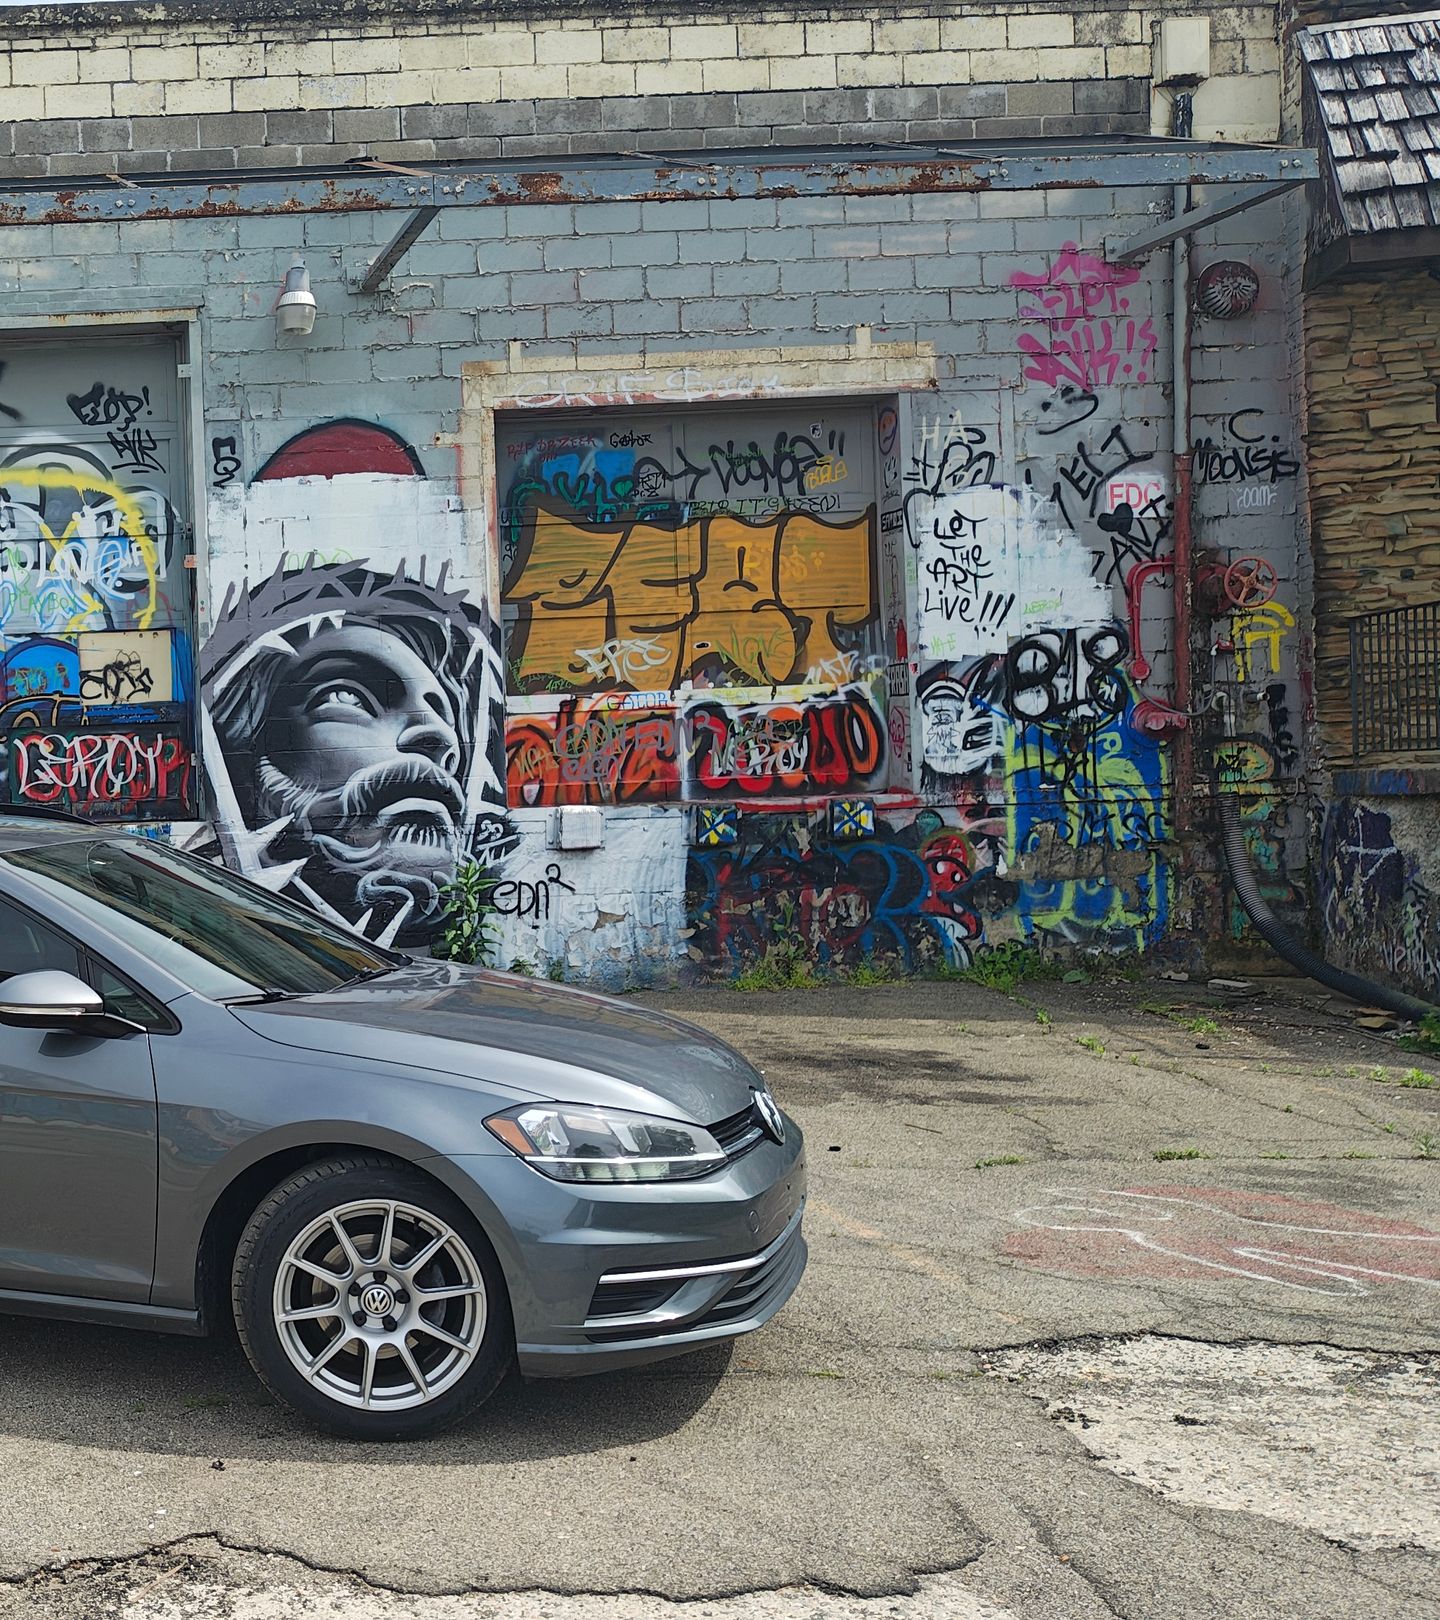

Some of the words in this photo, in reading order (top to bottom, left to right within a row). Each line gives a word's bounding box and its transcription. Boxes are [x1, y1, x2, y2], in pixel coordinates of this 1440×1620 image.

[1109, 480, 1162, 511] FDC
[933, 509, 989, 540] LeT
[939, 541, 991, 568] THe
[926, 556, 994, 600] ART
[12, 733, 163, 798] LEROY
